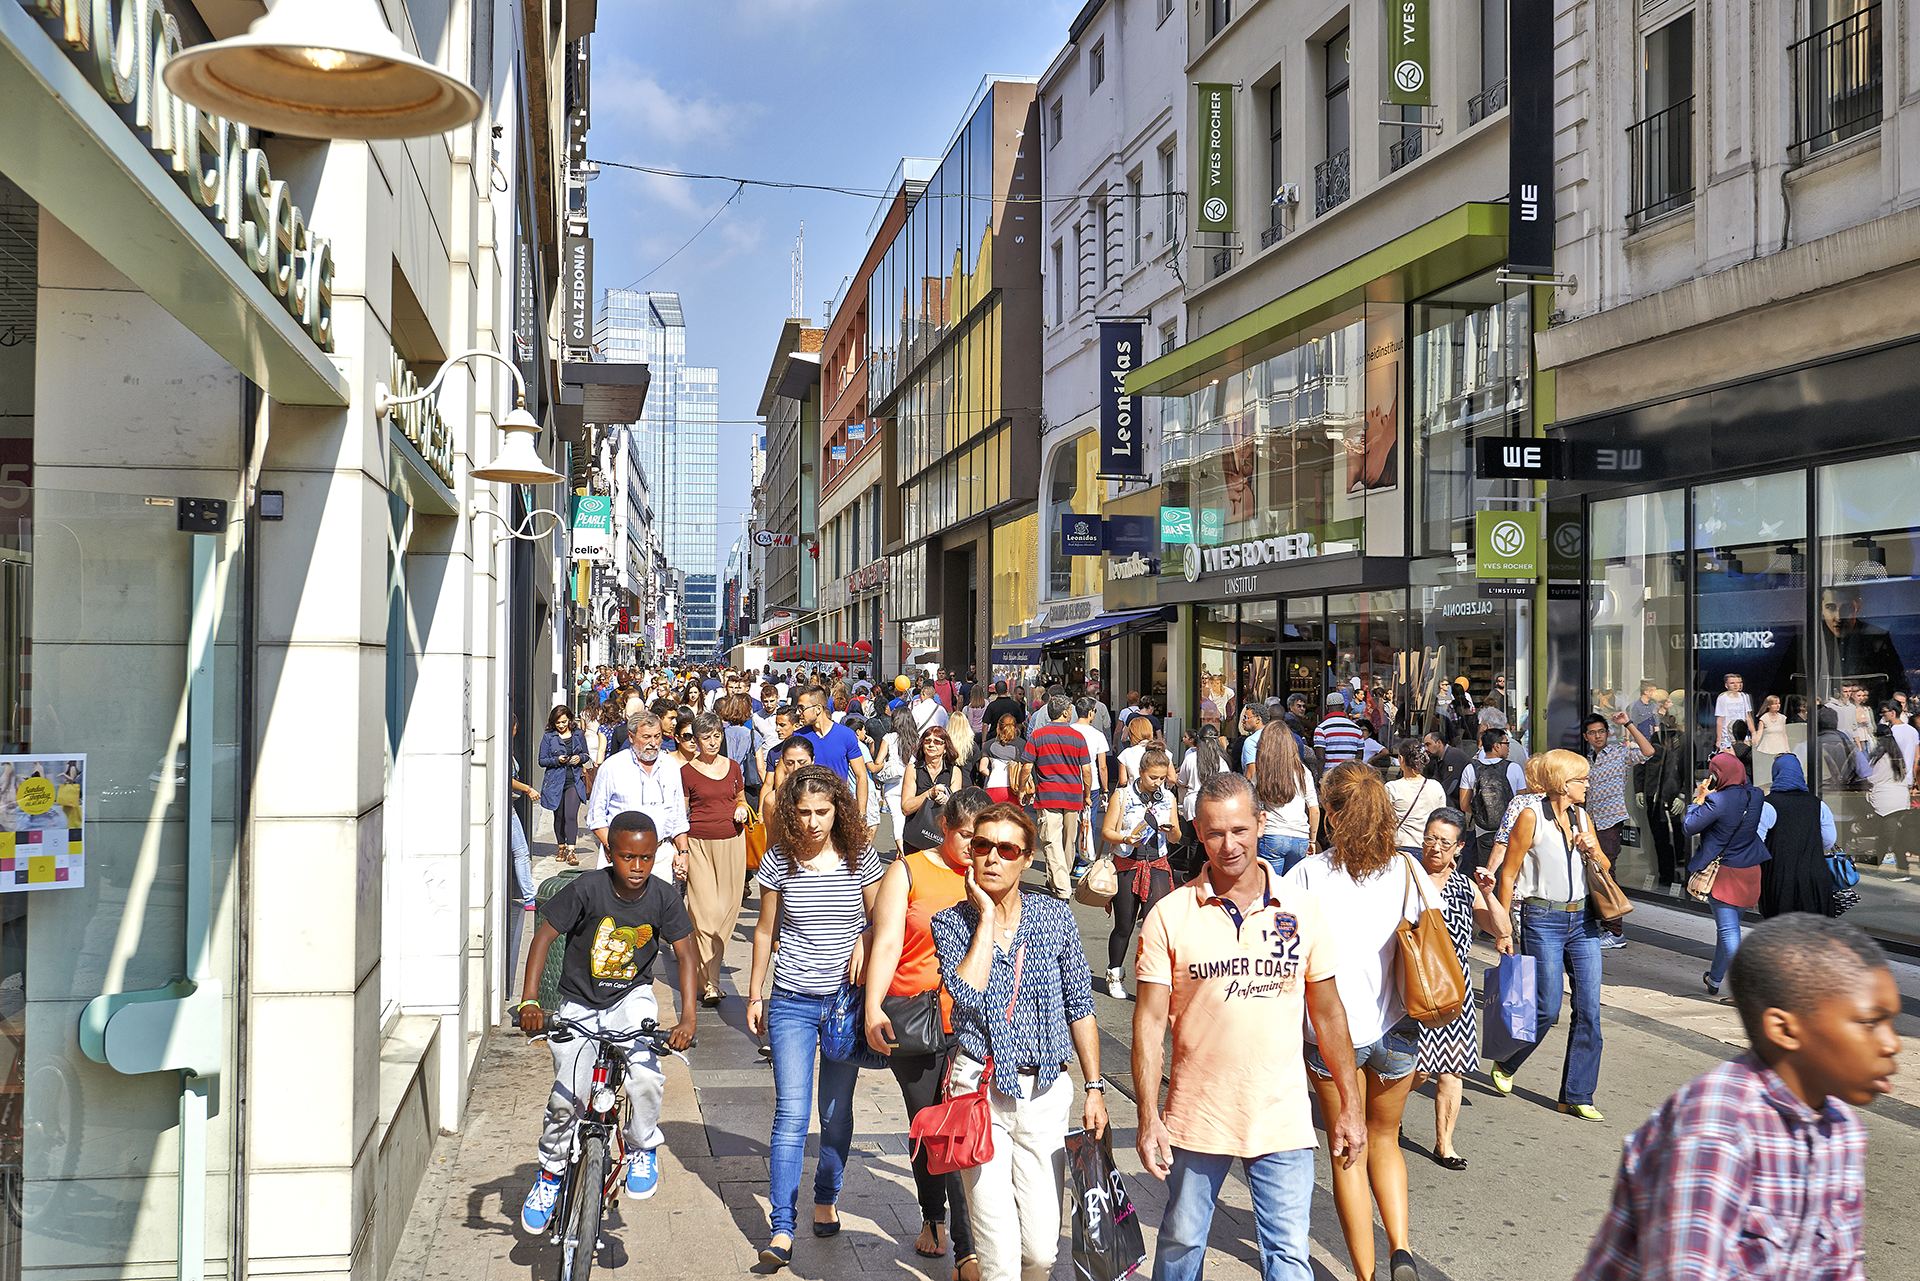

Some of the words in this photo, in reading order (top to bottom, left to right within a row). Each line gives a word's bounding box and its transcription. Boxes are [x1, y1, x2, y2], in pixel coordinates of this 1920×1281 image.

[1403, 2, 1415, 46] YVES
[1211, 92, 1221, 149] ROCHER
[1015, 128, 1025, 244] SISLEY
[1211, 153, 1221, 187] YVES
[1521, 184, 1538, 222] WE
[574, 245, 585, 339] CALZEDONIA
[1111, 340, 1132, 458] Leonidas
[1503, 446, 1542, 468] WE
[0, 464, 29, 509] 5
[576, 512, 607, 525] PEARLE
[758, 534, 772, 542] C&A
[1203, 544, 1240, 572] YVES
[1242, 532, 1310, 566] ROCHER
[1225, 576, 1257, 594] L'INSTITUT
[1622, 830, 1635, 841] WE
[1189, 958, 1249, 980] SUMMER
[1255, 959, 1299, 978] COAST
[1224, 979, 1284, 1002] Performing
